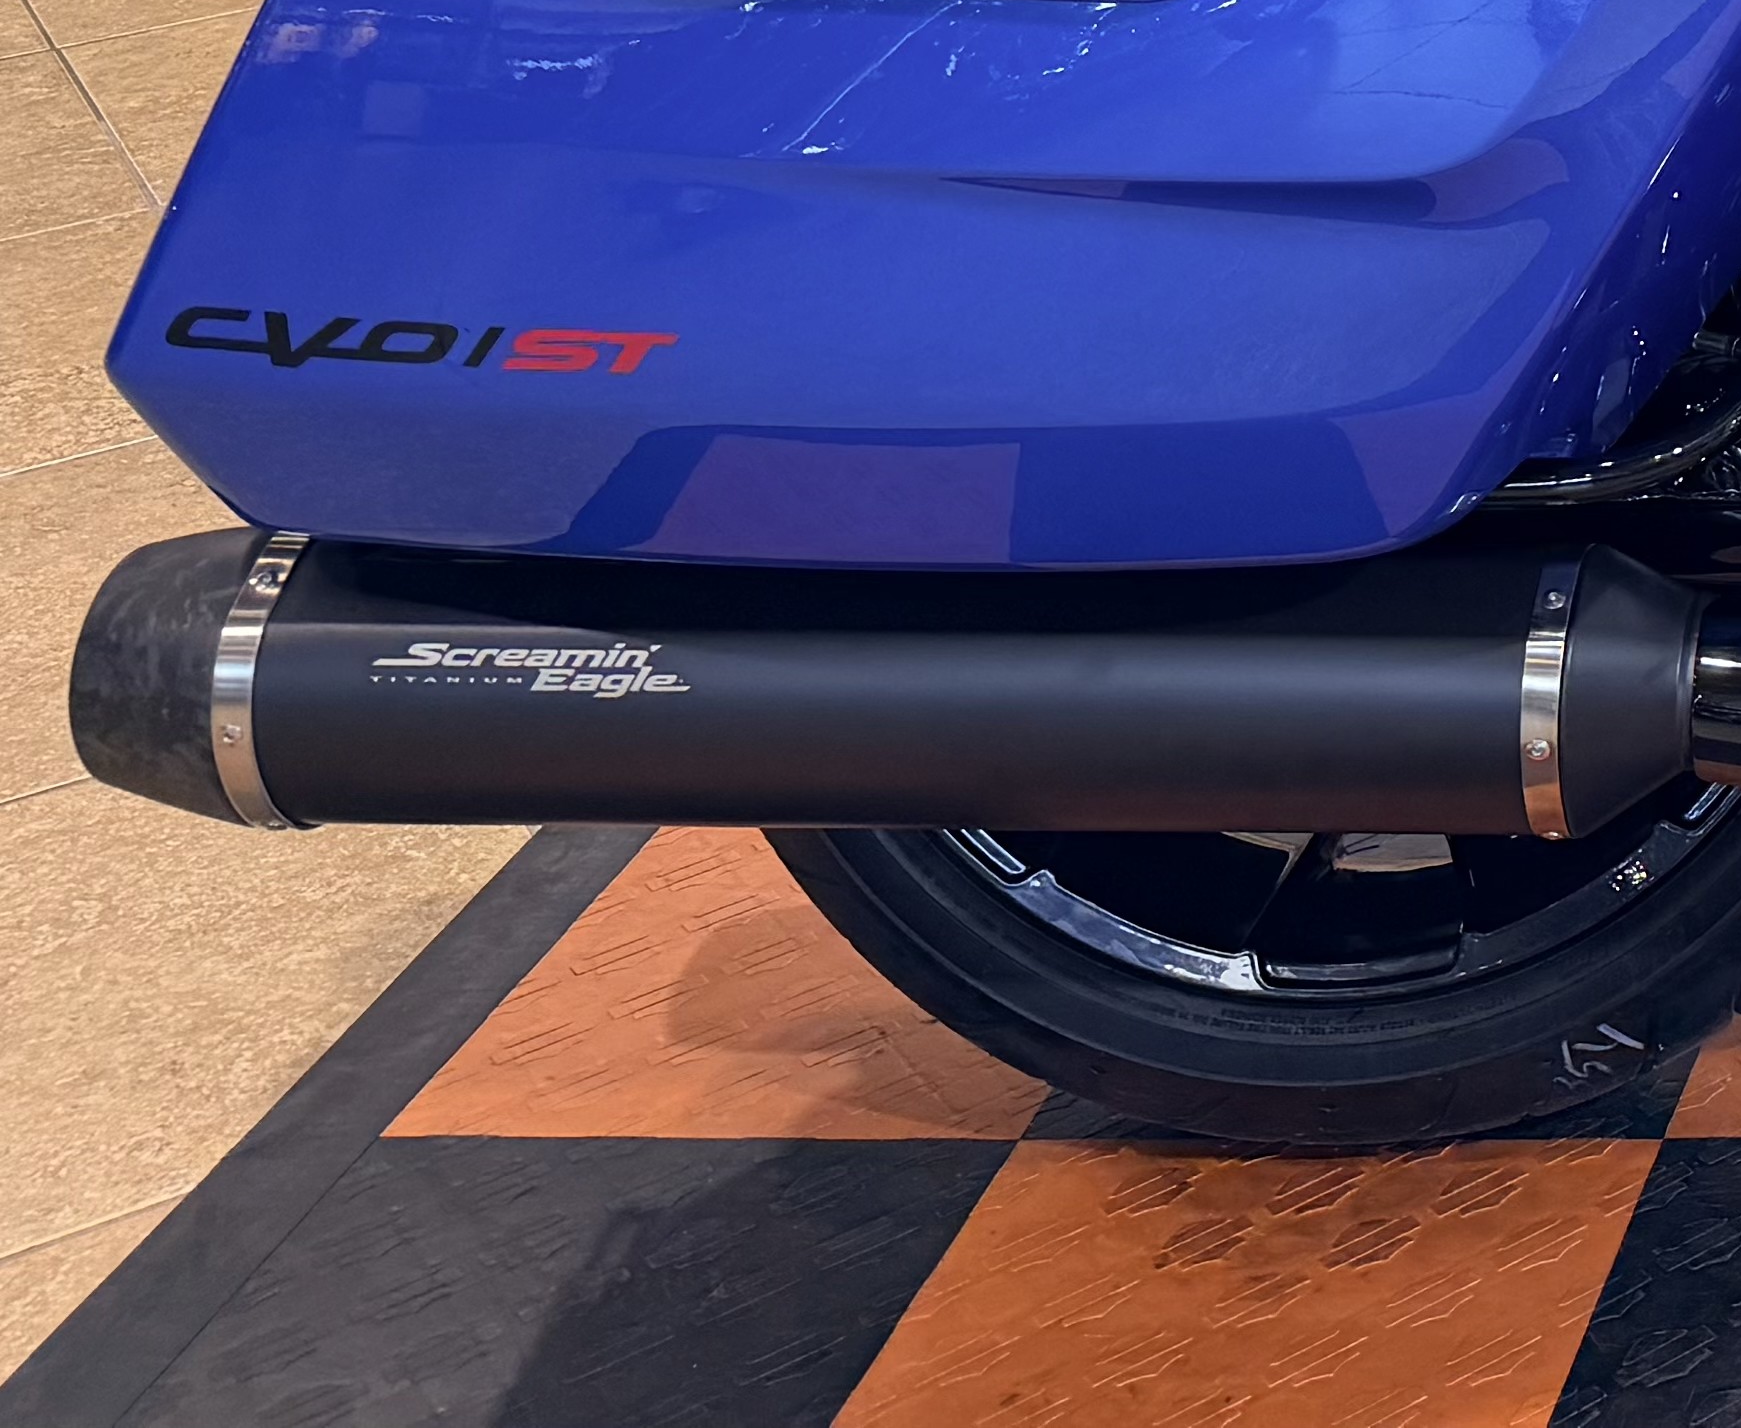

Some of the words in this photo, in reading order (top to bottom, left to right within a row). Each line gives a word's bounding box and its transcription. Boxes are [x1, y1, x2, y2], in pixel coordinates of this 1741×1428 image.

[371, 642, 662, 668] Screamin'
[369, 675, 523, 685] TITANIUM
[530, 666, 692, 699] Eagle
